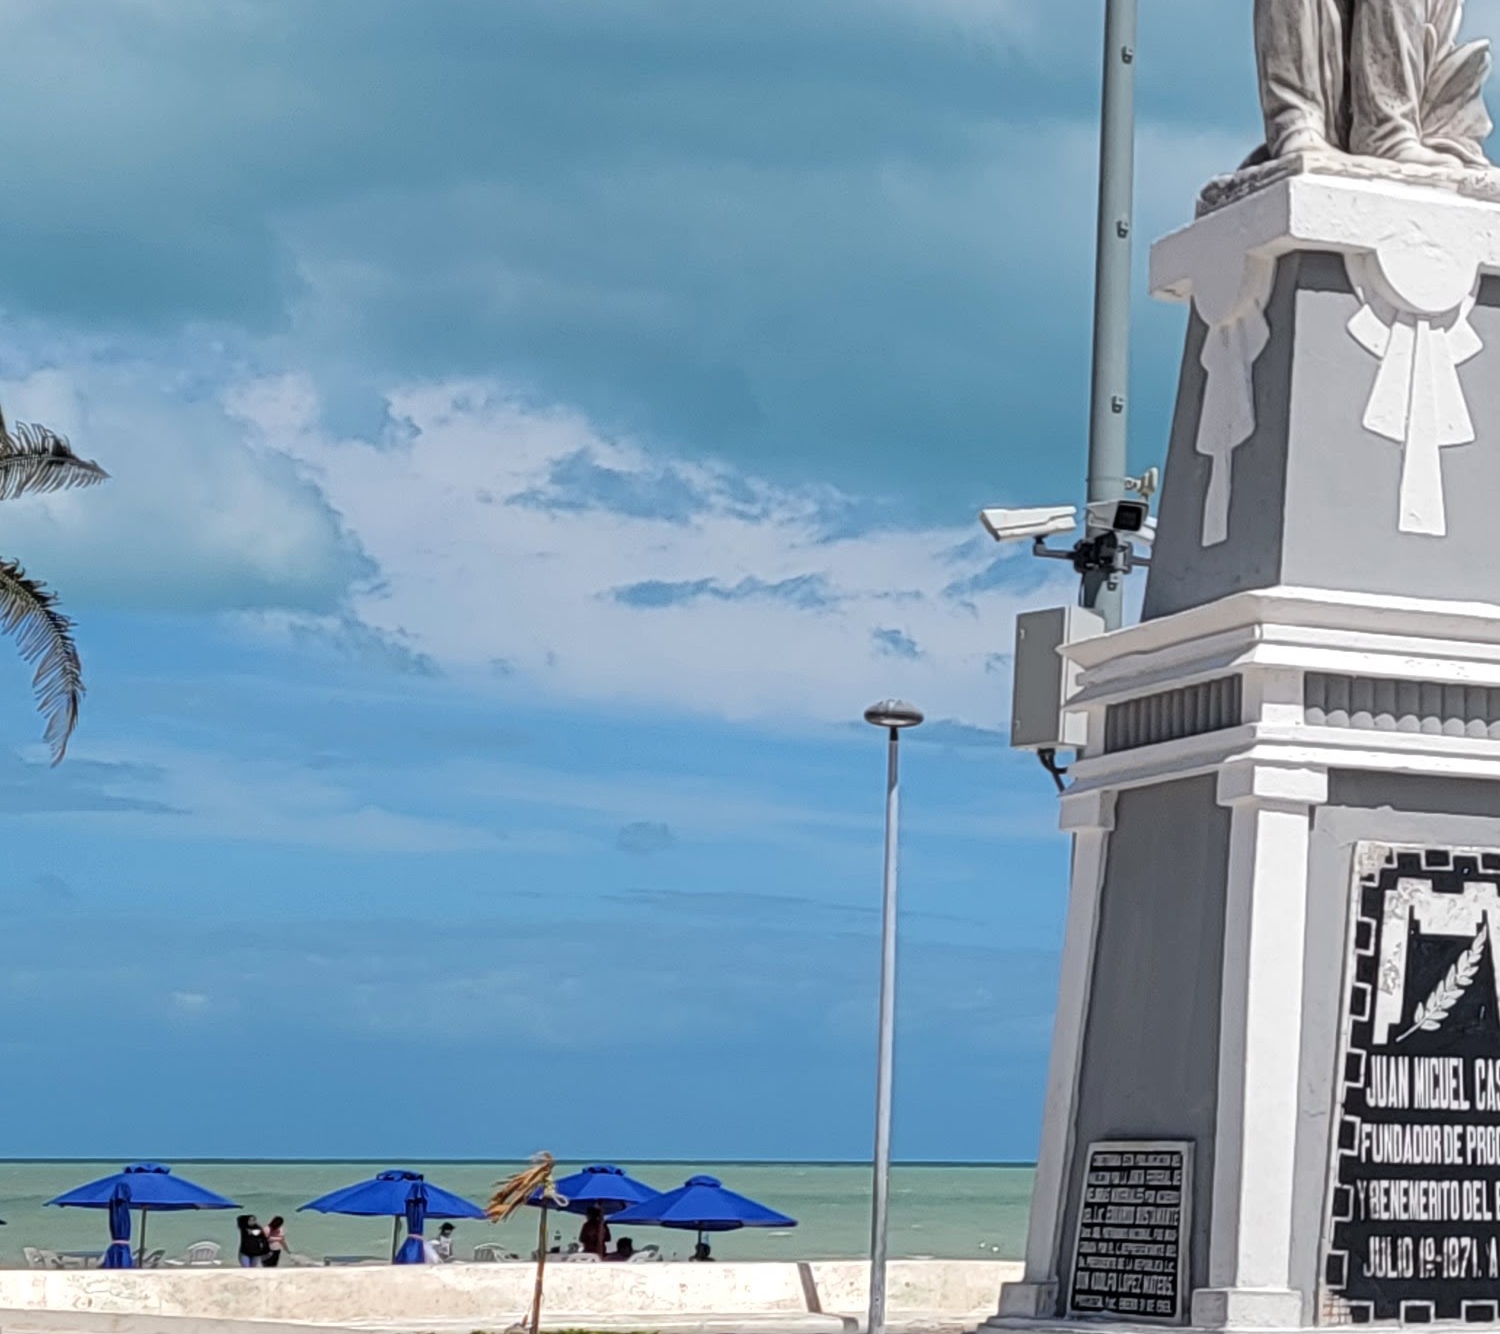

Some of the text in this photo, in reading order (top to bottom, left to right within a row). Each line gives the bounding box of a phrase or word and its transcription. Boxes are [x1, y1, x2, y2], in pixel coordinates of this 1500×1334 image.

[1366, 1055, 1409, 1108] JUAN
[1414, 1056, 1470, 1110] MIGUEL
[1361, 1123, 1441, 1164] FUNDADOR
[1444, 1124, 1463, 1165] DE
[1357, 1179, 1367, 1221] Y
[1369, 1179, 1459, 1221] BENEMERITO
[1462, 1180, 1492, 1221] DEL
[1363, 1235, 1414, 1278] JULIO
[1487, 1236, 1498, 1278] A
